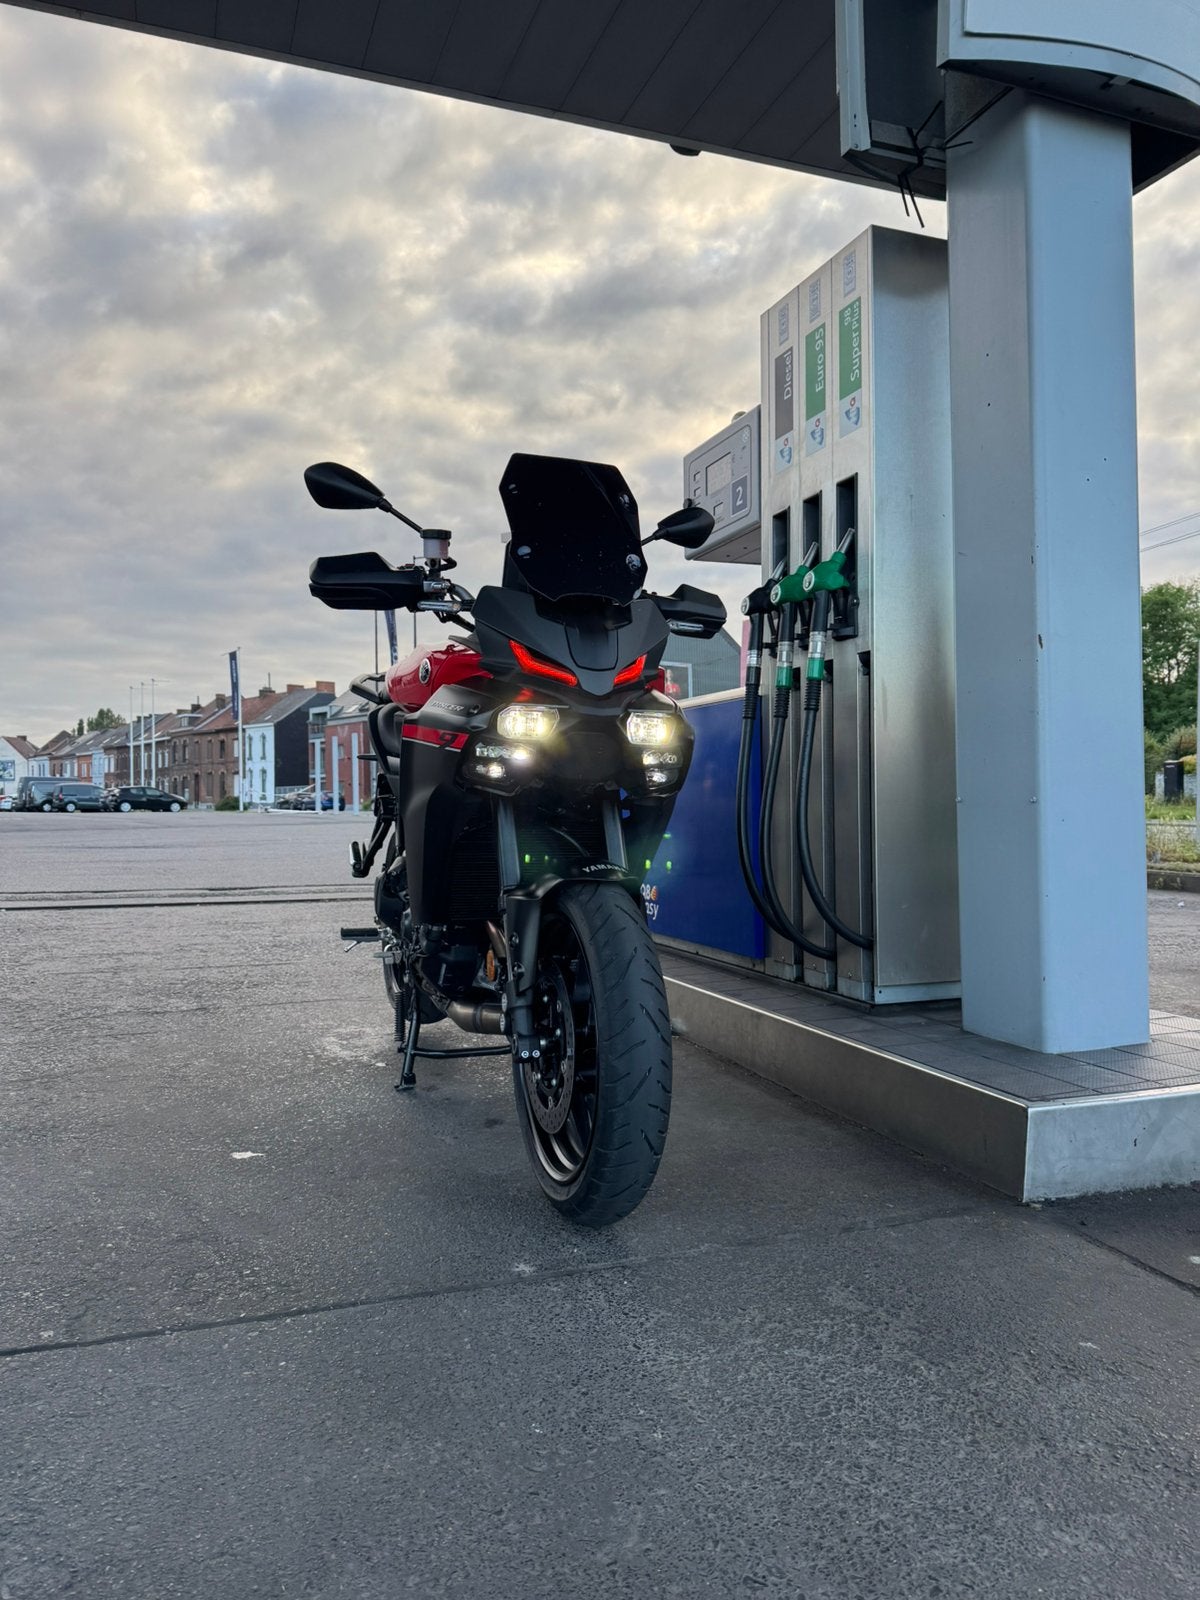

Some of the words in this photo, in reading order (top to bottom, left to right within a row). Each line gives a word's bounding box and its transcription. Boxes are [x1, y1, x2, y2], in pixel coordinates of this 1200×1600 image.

[844, 307, 851, 326] 98
[814, 327, 825, 351] 95
[850, 331, 862, 382] Super
[783, 350, 793, 400] Diesel
[815, 353, 825, 393] Euro
[735, 485, 744, 507] 2
[644, 901, 659, 920] asy
